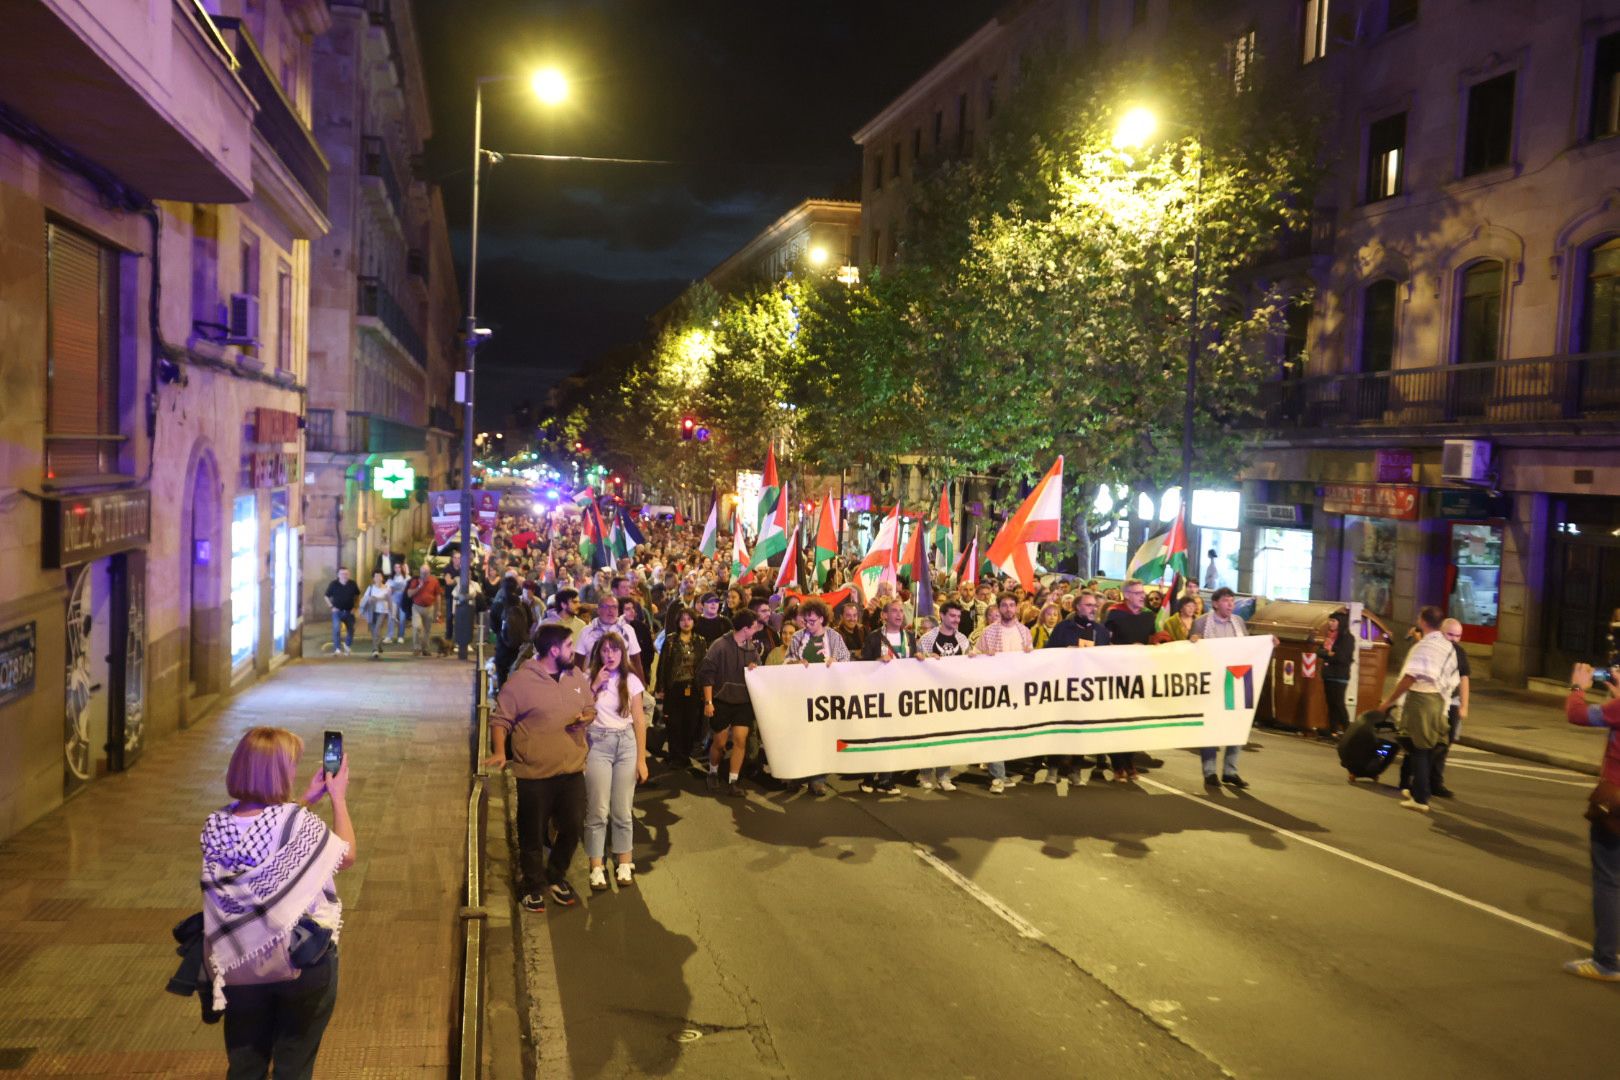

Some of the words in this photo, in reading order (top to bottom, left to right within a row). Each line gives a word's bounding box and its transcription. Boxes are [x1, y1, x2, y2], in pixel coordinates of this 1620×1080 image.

[807, 692, 892, 722] ISRAEL
[898, 685, 1018, 717] GENOCIDA,
[1024, 675, 1145, 706] PALESTINA
[1151, 671, 1212, 698] LIBRE
